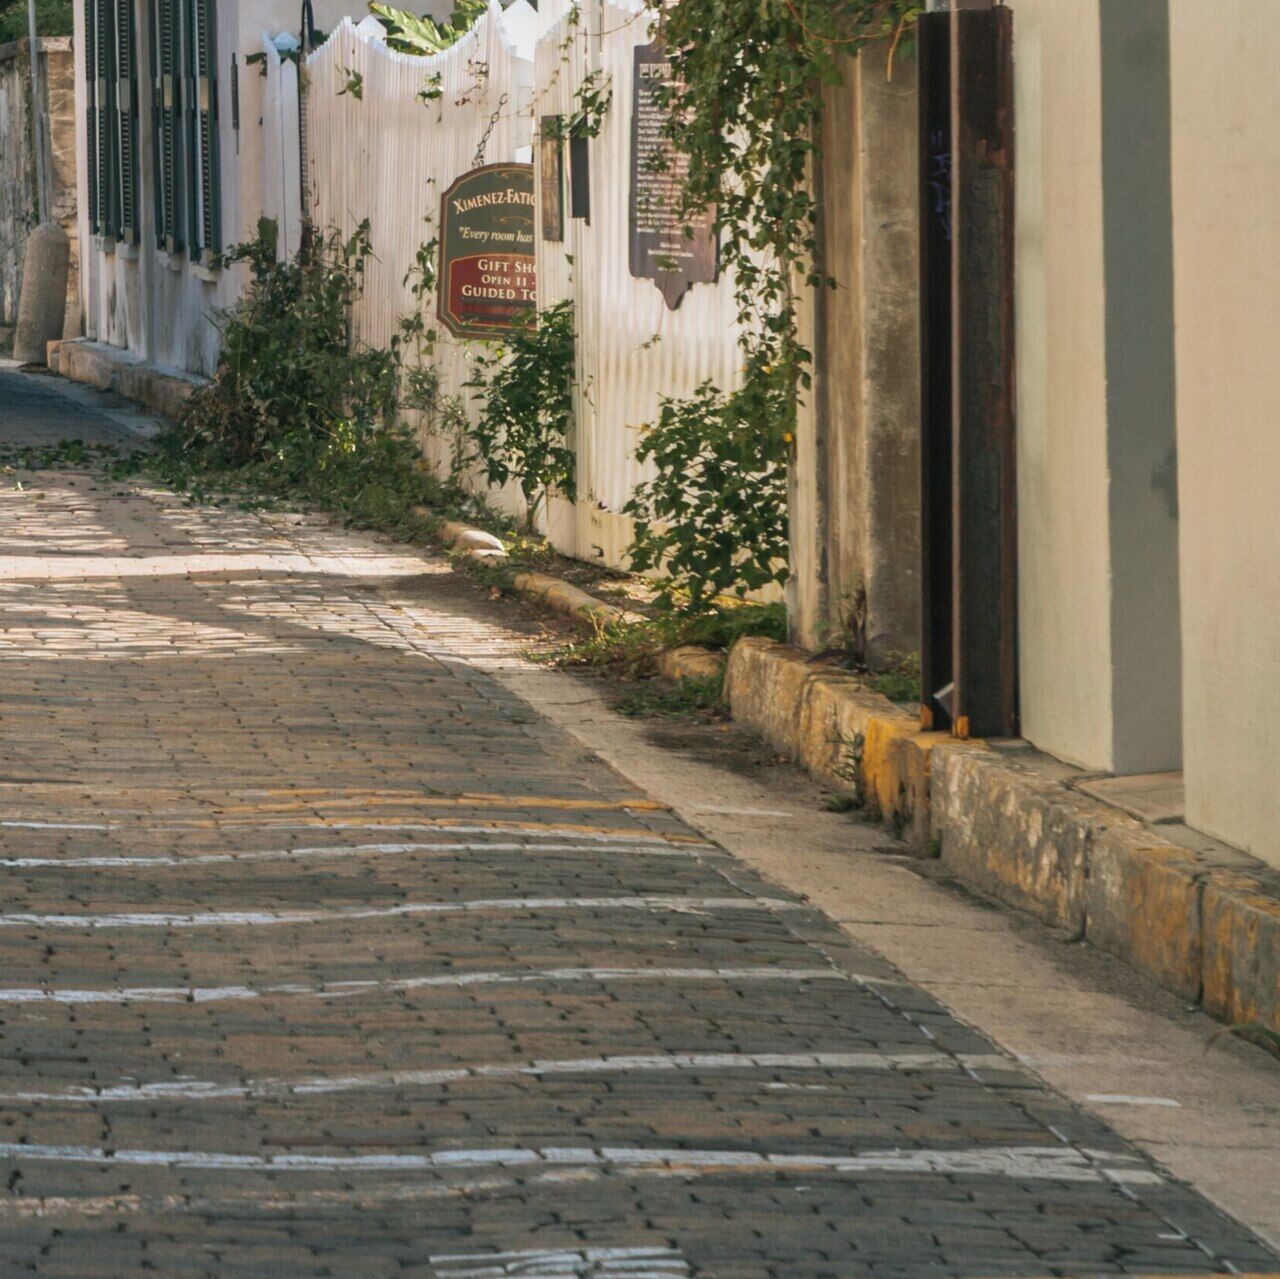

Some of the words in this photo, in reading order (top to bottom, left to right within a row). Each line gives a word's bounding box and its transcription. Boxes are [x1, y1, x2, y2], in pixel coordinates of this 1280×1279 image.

[491, 231, 515, 242] room
[516, 230, 533, 243] has
[477, 258, 510, 272] GIFT
[481, 274, 511, 286] OPEN
[516, 275, 526, 286] 11
[461, 284, 516, 300] GUIDED
